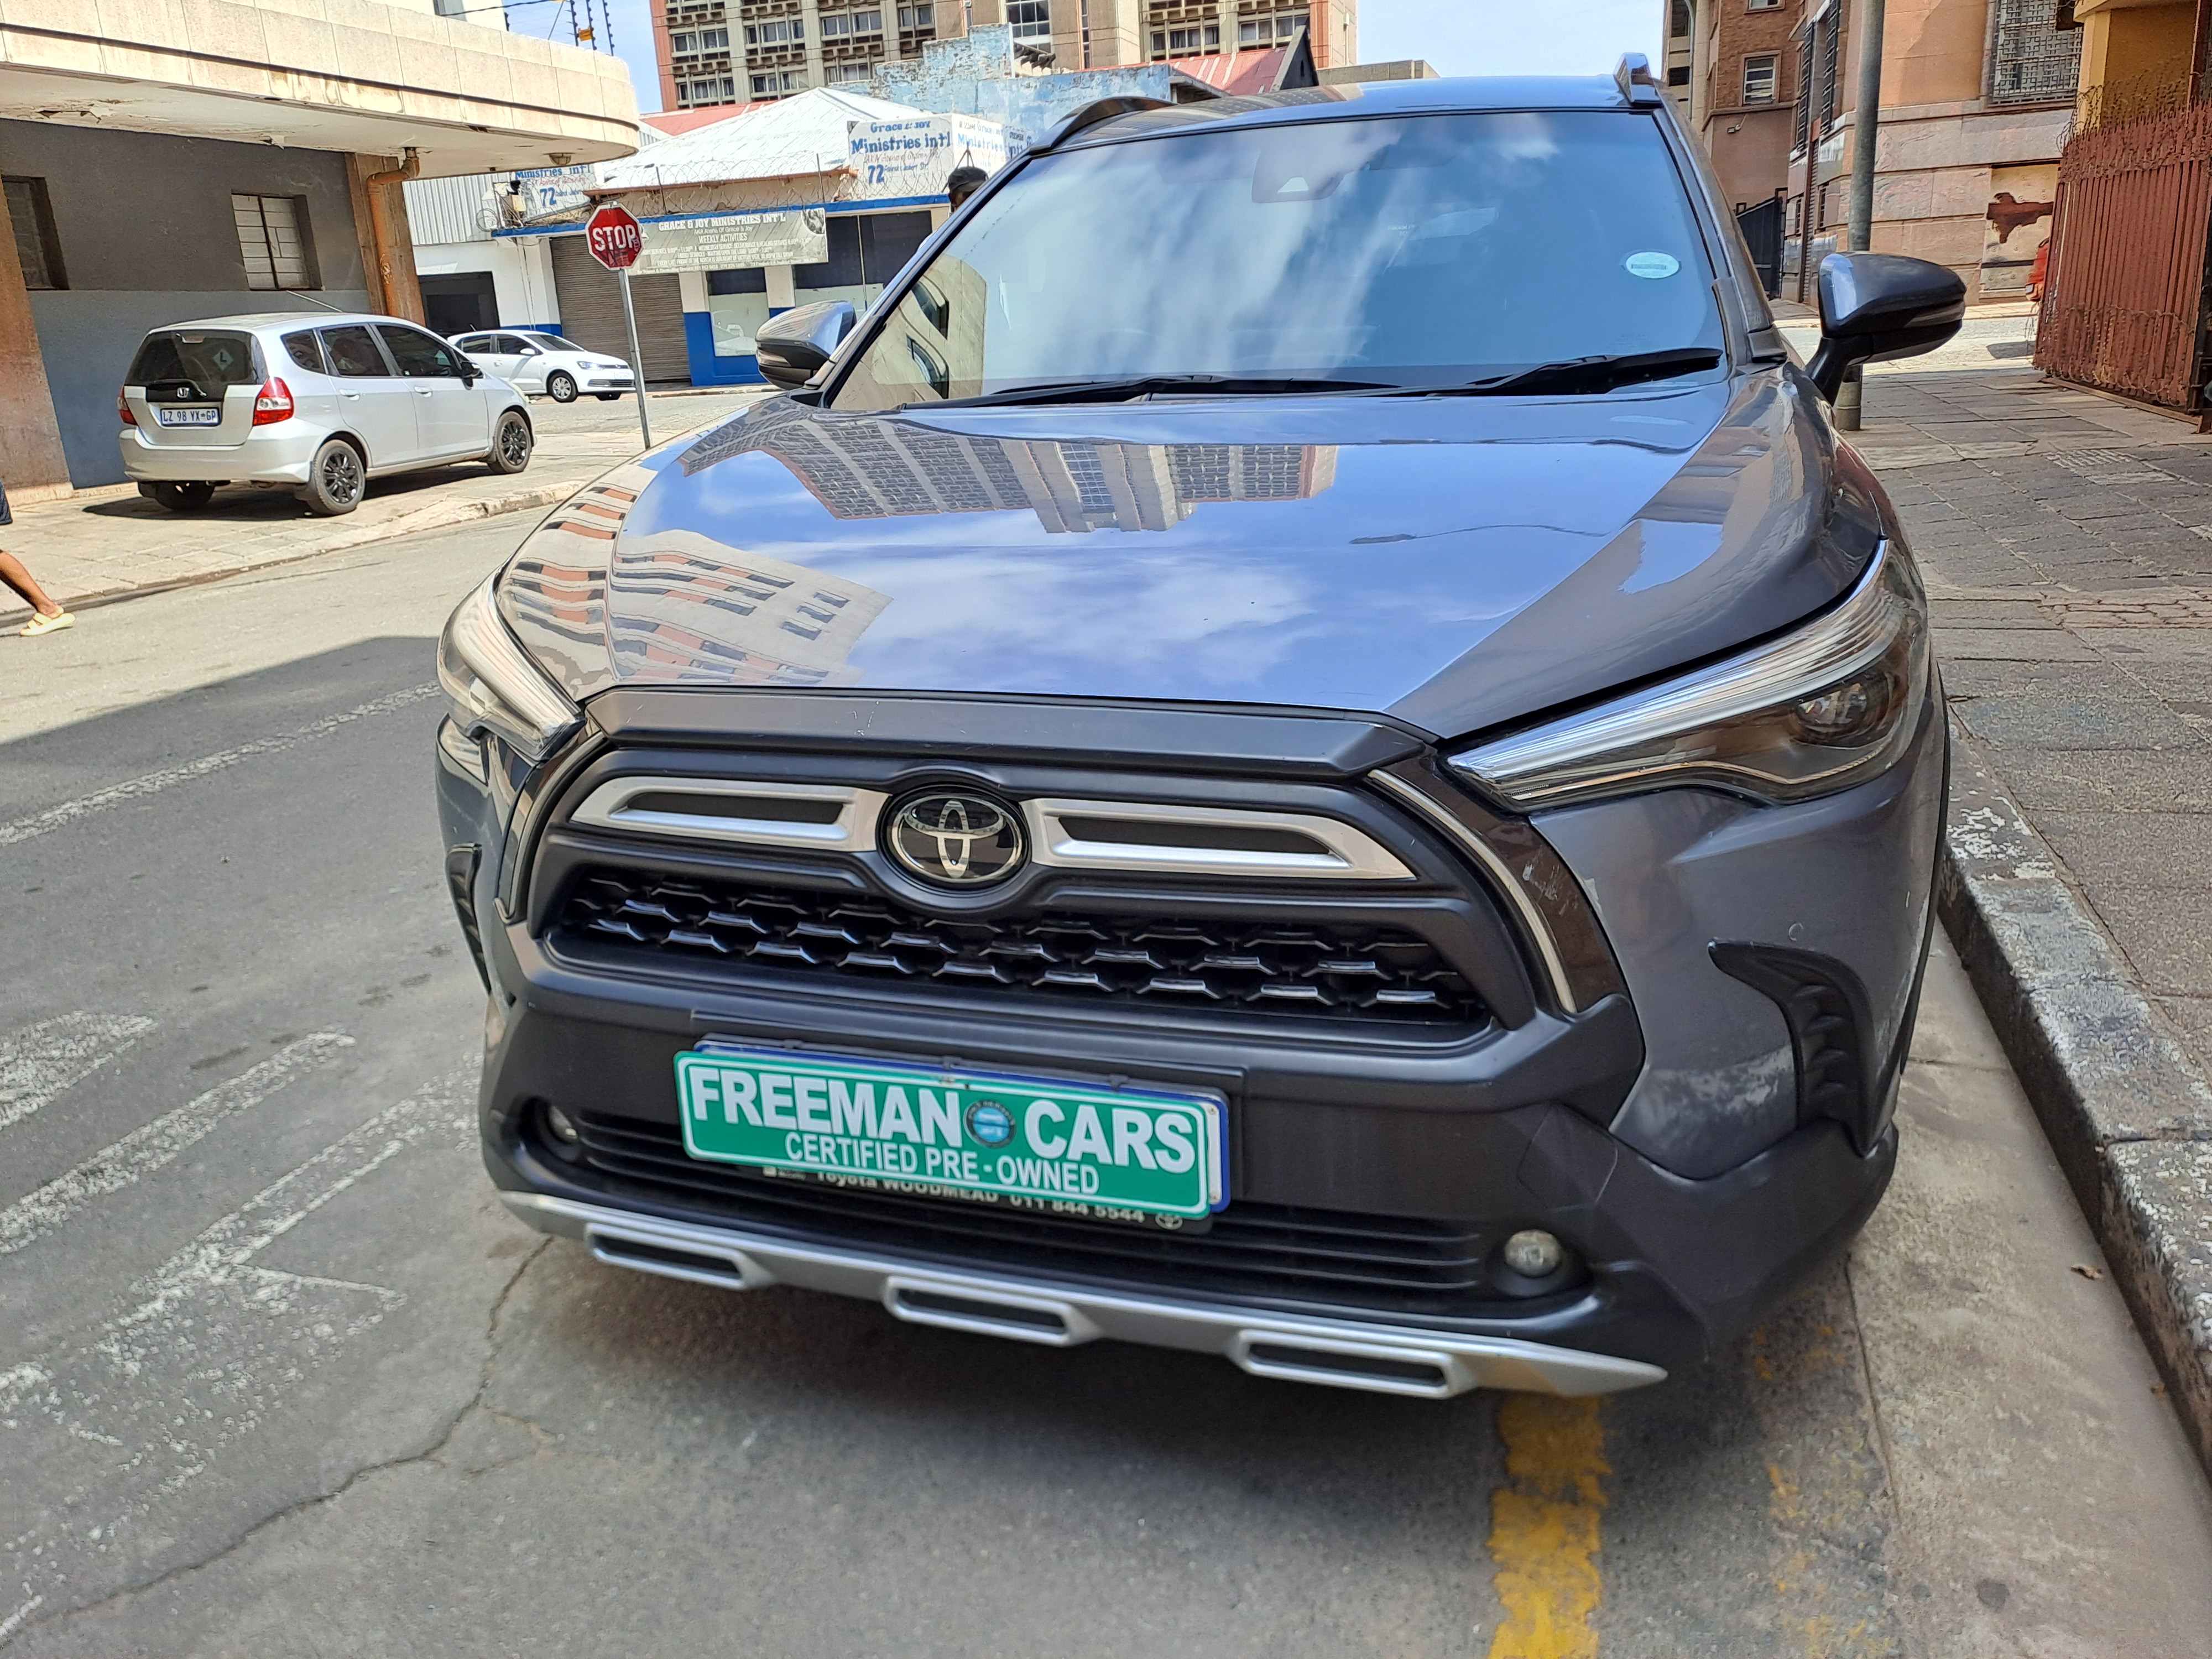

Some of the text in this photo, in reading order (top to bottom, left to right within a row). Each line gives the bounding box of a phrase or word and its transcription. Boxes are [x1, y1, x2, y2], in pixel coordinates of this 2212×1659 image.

[870, 122, 902, 133] Grace
[851, 135, 921, 155] Ministries
[515, 167, 562, 180] Ministries
[868, 164, 885, 184] 72
[539, 187, 557, 208] 72
[658, 212, 786, 231] GRACE & JOY MINISTRIES INT'L
[592, 225, 636, 252] STOP
[698, 232, 748, 244] WEEKLY ACTIVITIES
[220, 351, 227, 363] L
[163, 410, 216, 422] LZ 98 YX GP
[688, 1066, 963, 1148] FREEMAN
[1024, 1099, 1196, 1174] CARS
[785, 1132, 917, 1173] CERTIFIED
[925, 1147, 979, 1181] PRE
[997, 1155, 1099, 1196] OWNED
